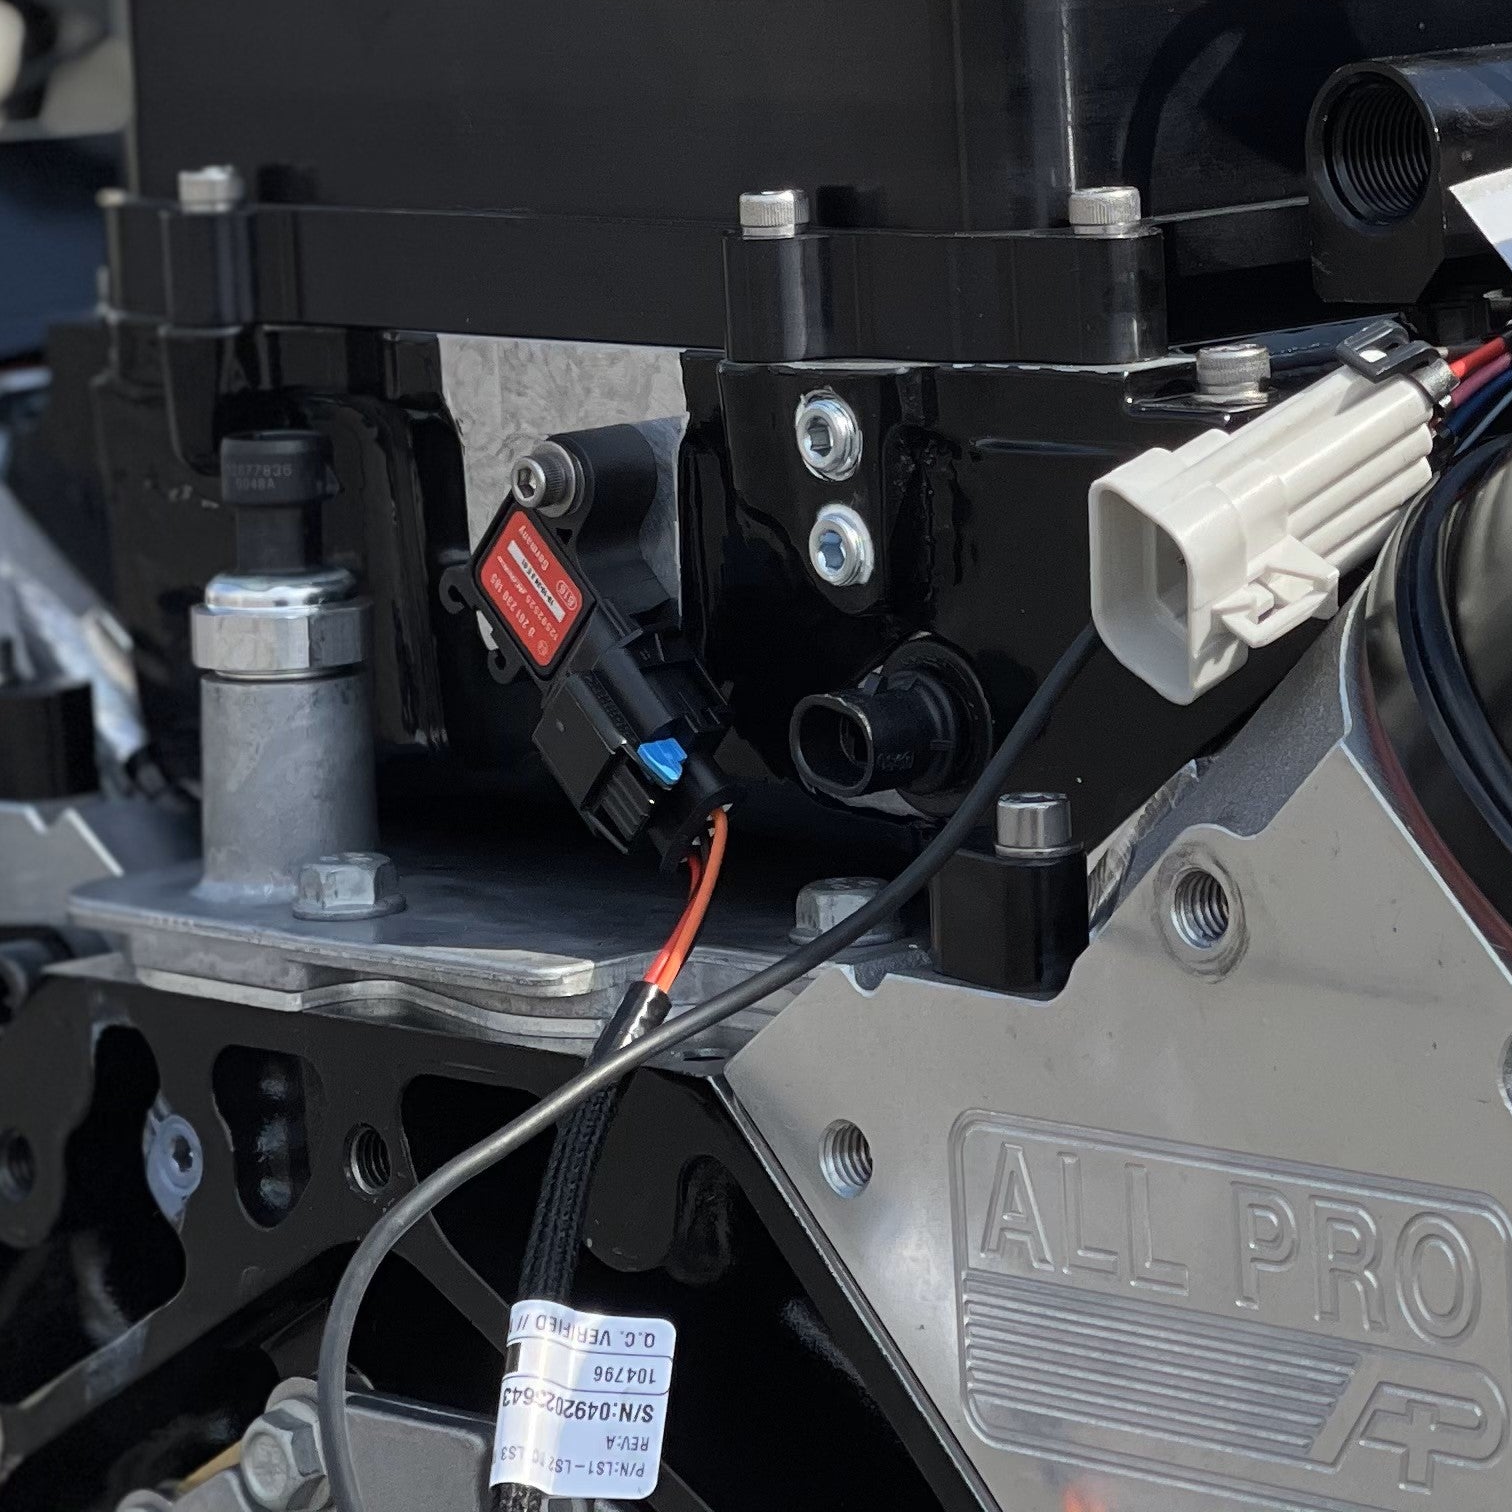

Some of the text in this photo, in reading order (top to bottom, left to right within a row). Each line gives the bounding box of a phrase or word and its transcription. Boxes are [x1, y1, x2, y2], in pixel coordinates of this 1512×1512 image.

[518, 525, 550, 571] Germany
[980, 1142, 1482, 1346] ALL PRO
[535, 1314, 611, 1347] VERIFIED
[619, 1330, 656, 1348] Q.C.
[593, 1365, 657, 1384] 104796
[606, 1436, 649, 1451] REV:A
